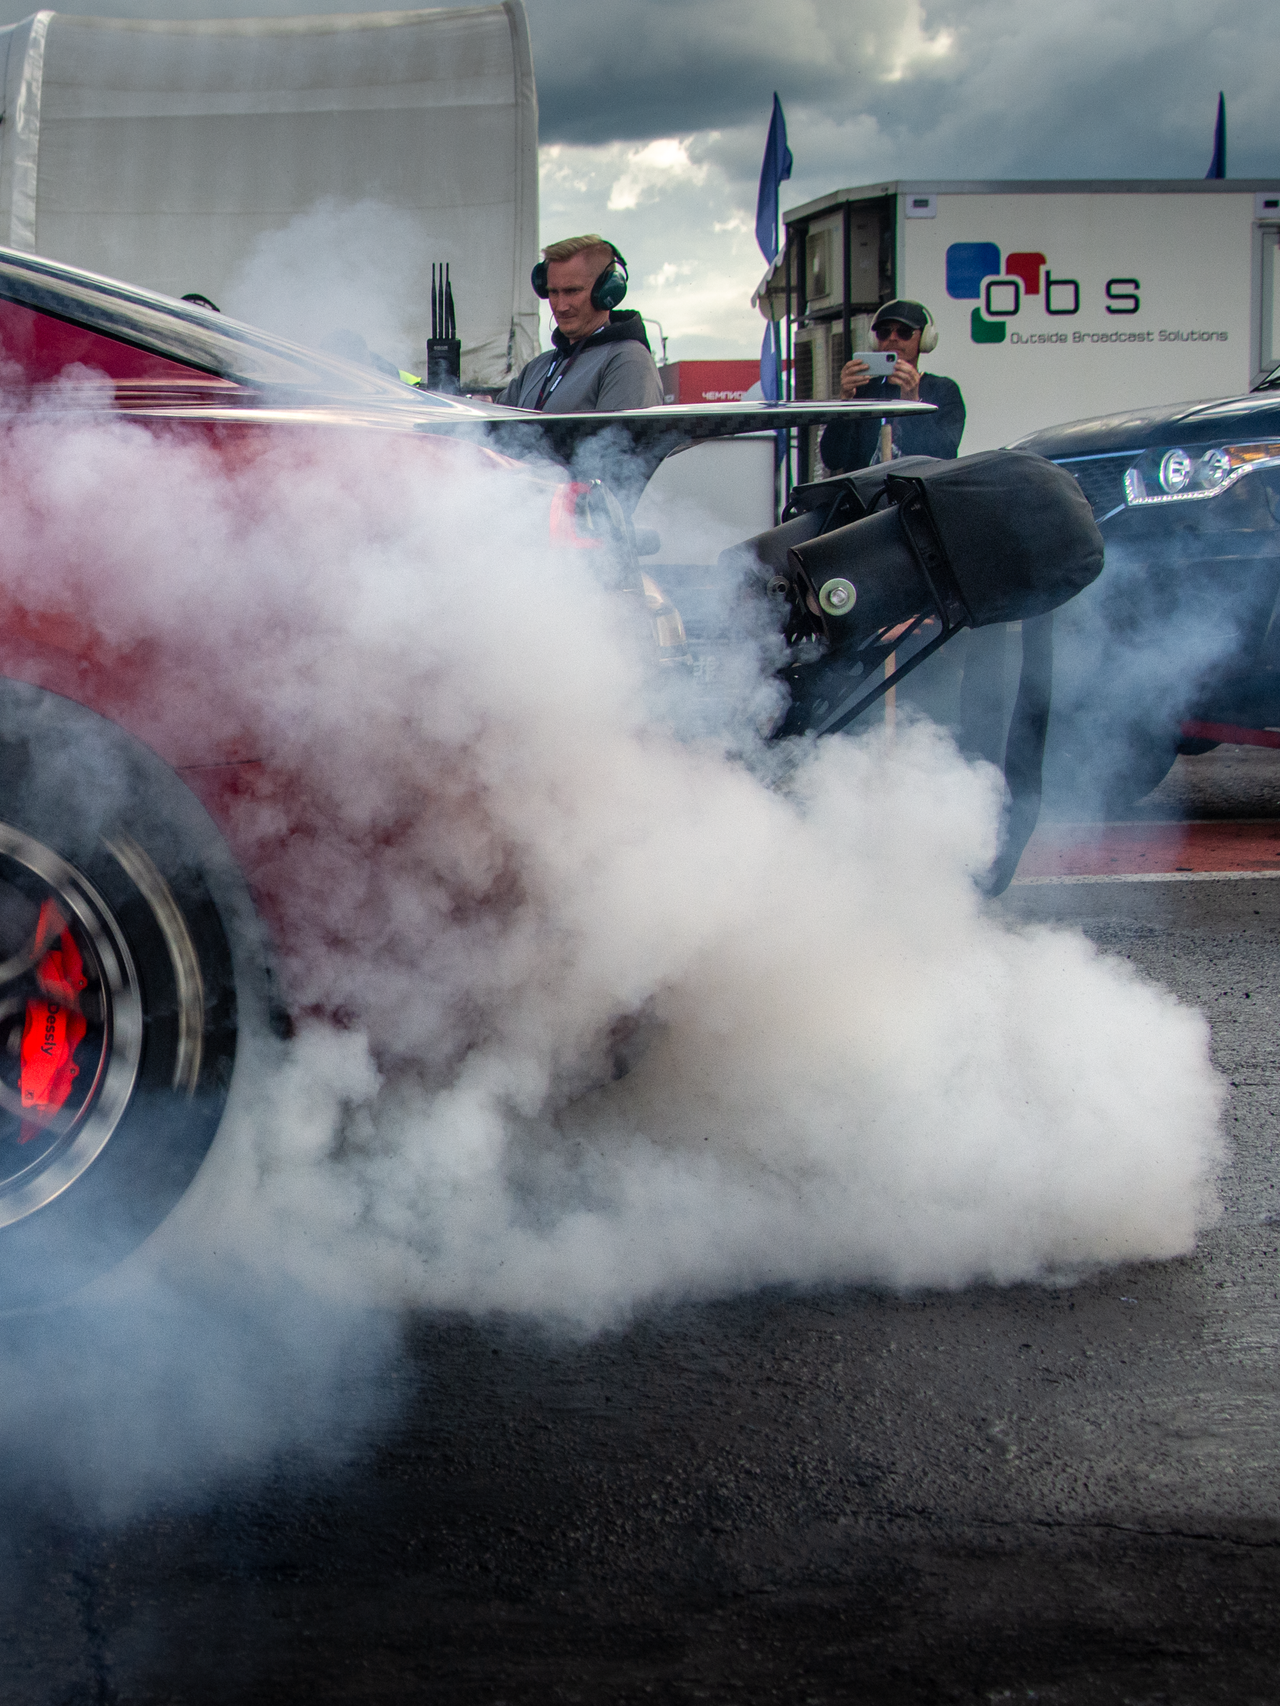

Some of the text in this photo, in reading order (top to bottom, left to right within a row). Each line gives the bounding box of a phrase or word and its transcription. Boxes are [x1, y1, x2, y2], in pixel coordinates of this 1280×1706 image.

[1010, 329, 1229, 345] Outside Broadcast Solutions
[40, 1001, 60, 1057] Dessly
